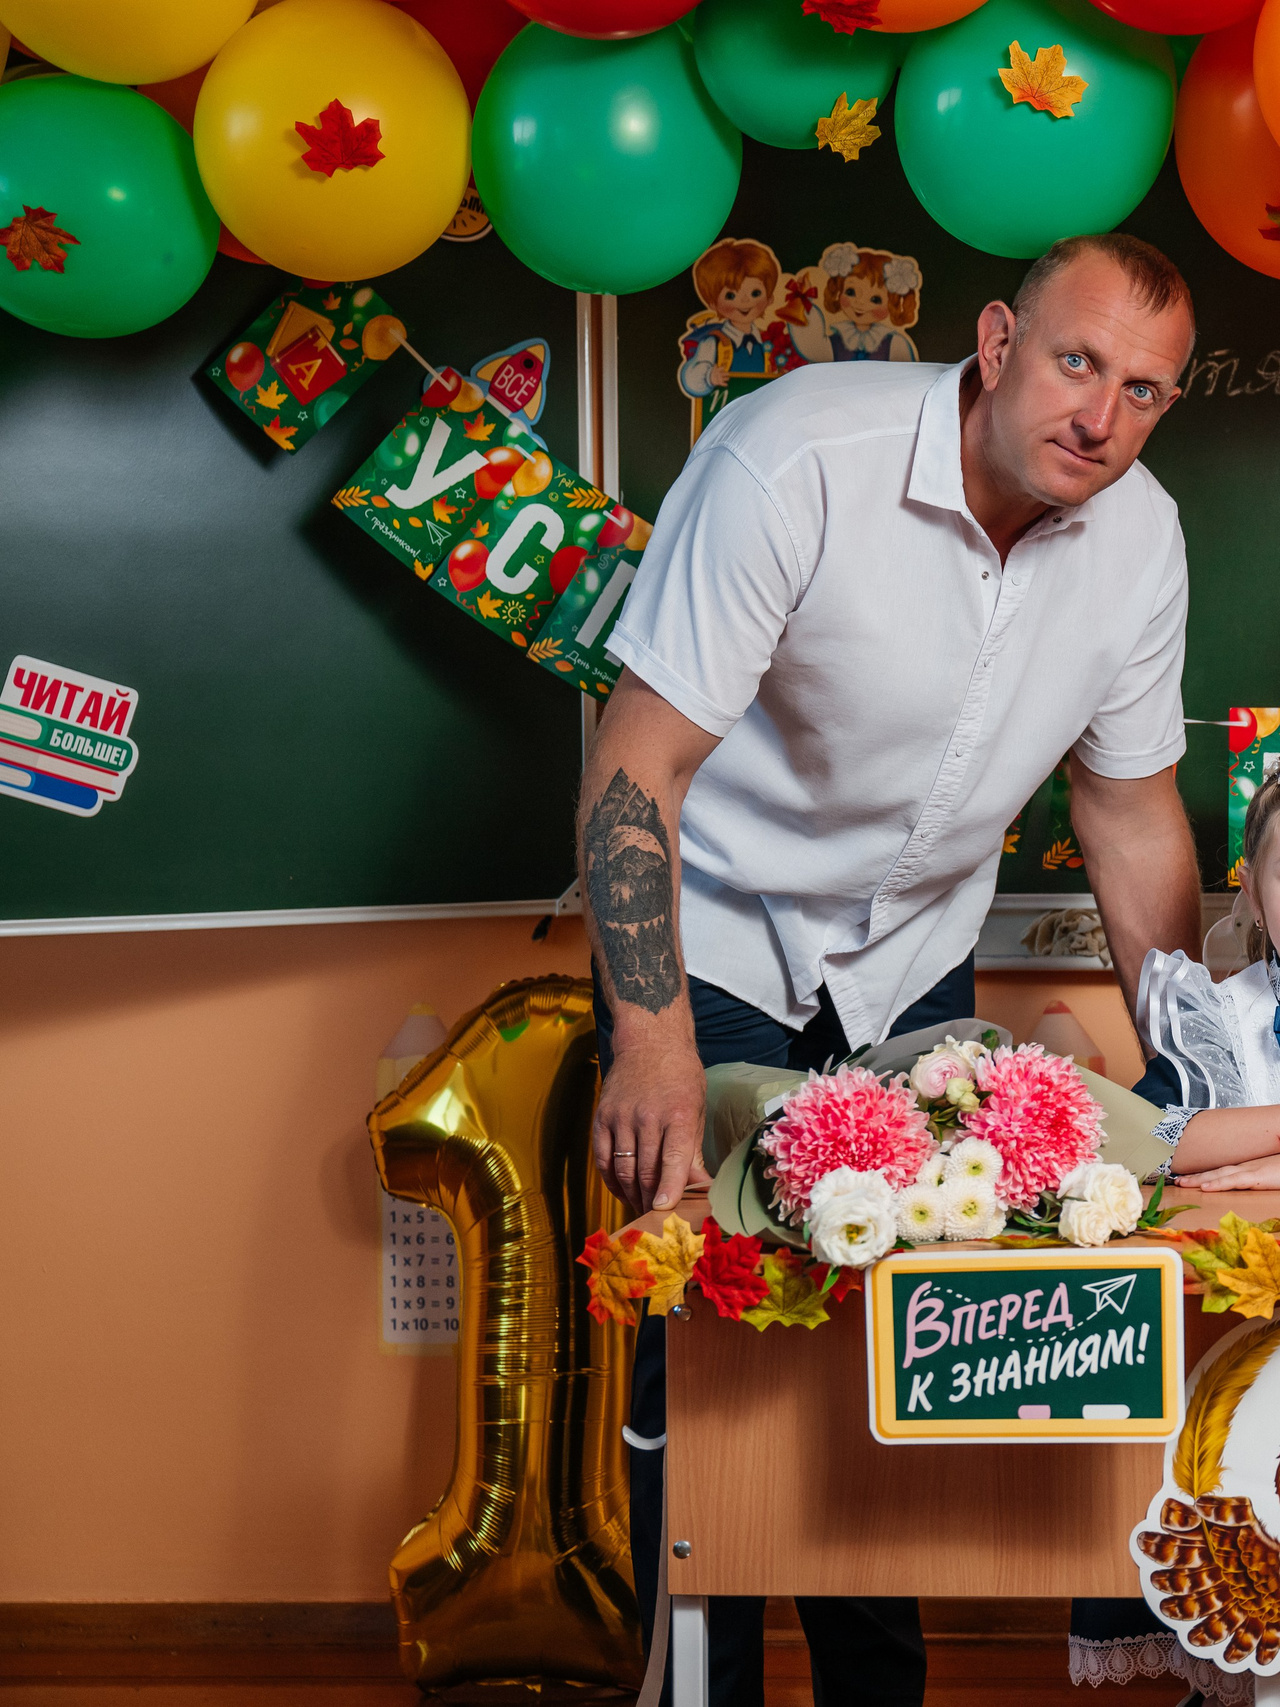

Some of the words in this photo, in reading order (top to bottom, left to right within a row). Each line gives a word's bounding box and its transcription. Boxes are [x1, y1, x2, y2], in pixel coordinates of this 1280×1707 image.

[287, 358, 322, 391] А
[494, 364, 537, 406] ВСЁ
[371, 516, 421, 558] праздником!
[565, 650, 590, 670] День
[592, 667, 617, 685] знани
[13, 667, 131, 736] ЧИТАЙ
[50, 728, 128, 767] БОЛЬШЕ!
[390, 1211, 397, 1223] 1
[417, 1211, 425, 1223] 5
[390, 1232, 397, 1245] 1
[416, 1232, 425, 1245] 6
[446, 1232, 455, 1245] 6
[390, 1254, 397, 1267] 1
[416, 1254, 425, 1267] 7
[445, 1254, 454, 1267] 7
[390, 1275, 397, 1288] 1
[416, 1275, 425, 1288] 8
[446, 1275, 455, 1288] 8
[390, 1296, 397, 1309] 1
[416, 1296, 425, 1309] 9
[446, 1296, 455, 1309] 9
[390, 1318, 397, 1331] 1
[413, 1318, 429, 1331] 10
[444, 1318, 459, 1331] 10
[907, 1371, 935, 1413] К
[948, 1322, 1150, 1403] ЗНАНИЯМ!
